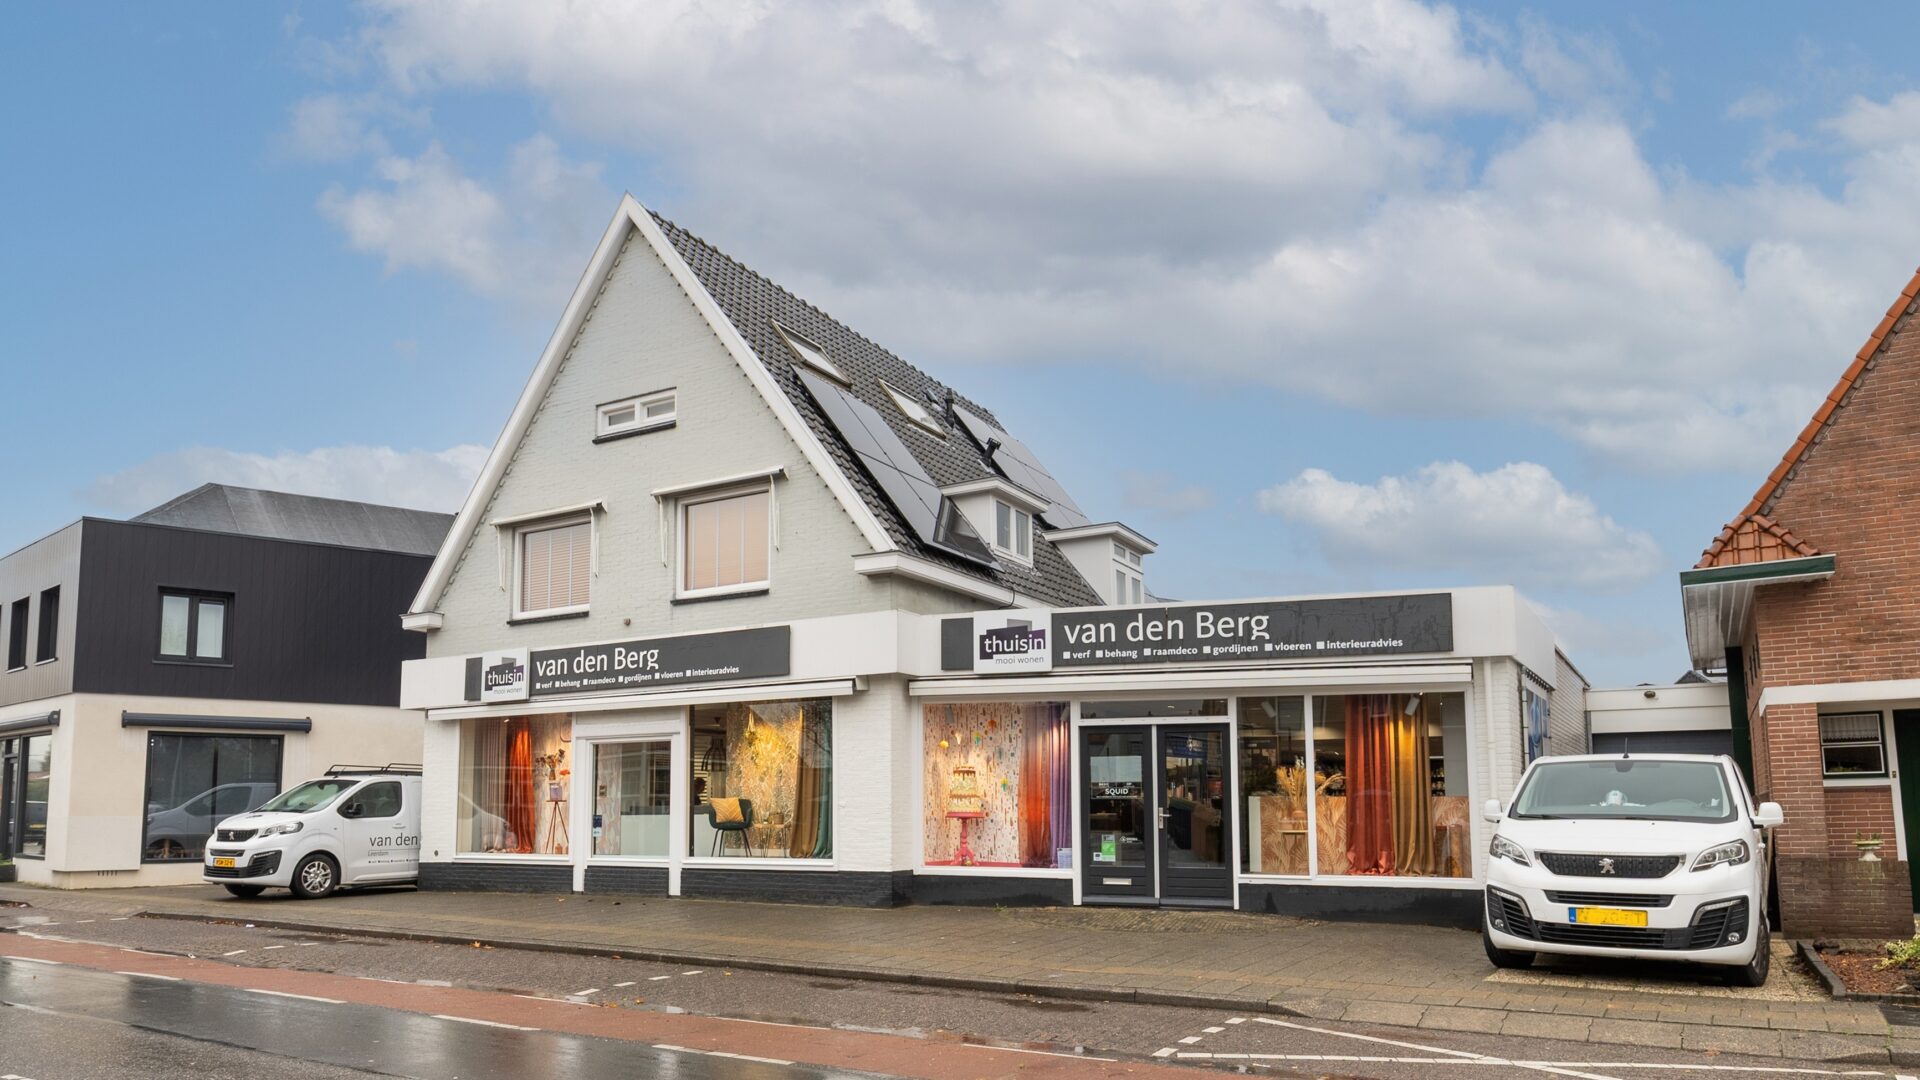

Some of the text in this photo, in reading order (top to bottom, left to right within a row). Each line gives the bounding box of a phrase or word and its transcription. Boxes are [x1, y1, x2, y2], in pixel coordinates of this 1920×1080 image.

[1063, 611, 1270, 644] van den Berg
[984, 633, 1044, 653] thuisin
[1072, 638, 1403, 659] verf behang raamdeco gordijnen vloeren interieuradvies
[536, 647, 659, 677] van den Berg
[995, 656, 1044, 664] mooi wonen
[487, 669, 523, 685] thuisin
[541, 665, 739, 689] verf behang raamdeco gordijnen vloeren interieuradvies
[1105, 788, 1129, 796] SQUID
[369, 832, 417, 846] van den
